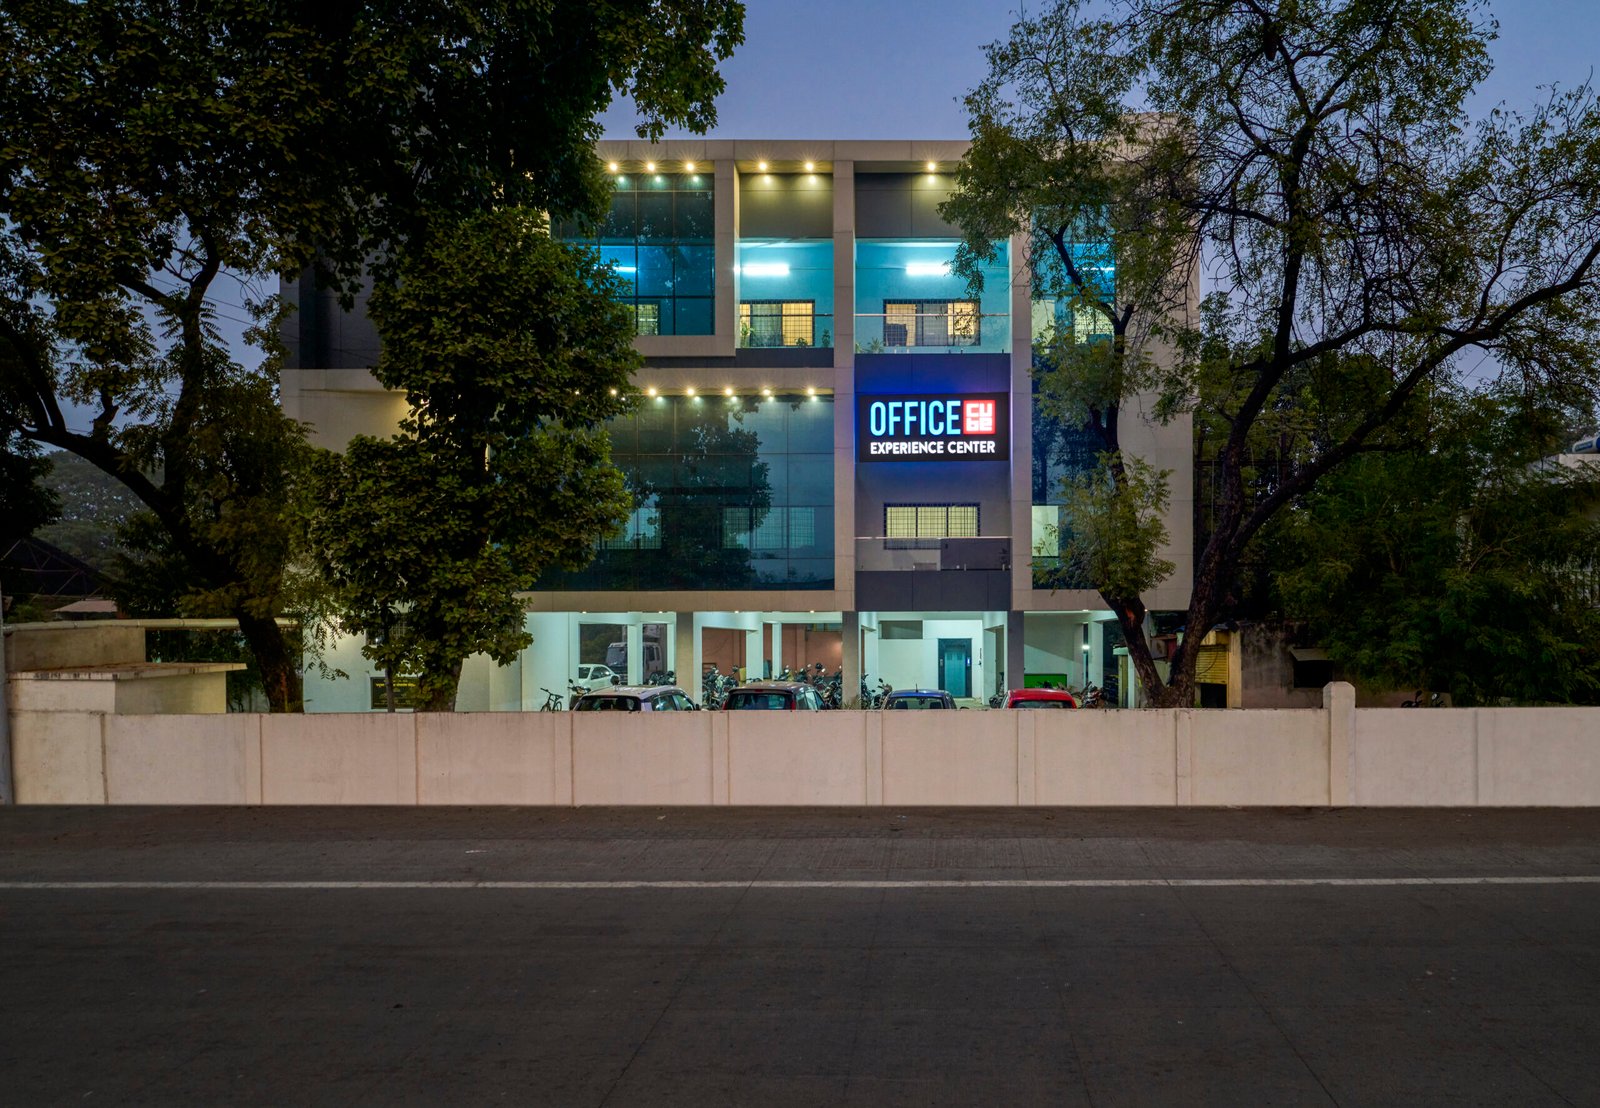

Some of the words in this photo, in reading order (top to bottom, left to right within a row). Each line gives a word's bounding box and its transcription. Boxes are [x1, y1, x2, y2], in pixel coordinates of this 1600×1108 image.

[870, 400, 961, 436] OFFICE
[870, 441, 944, 455] EXPERIENCE
[947, 440, 996, 454] CENTER
